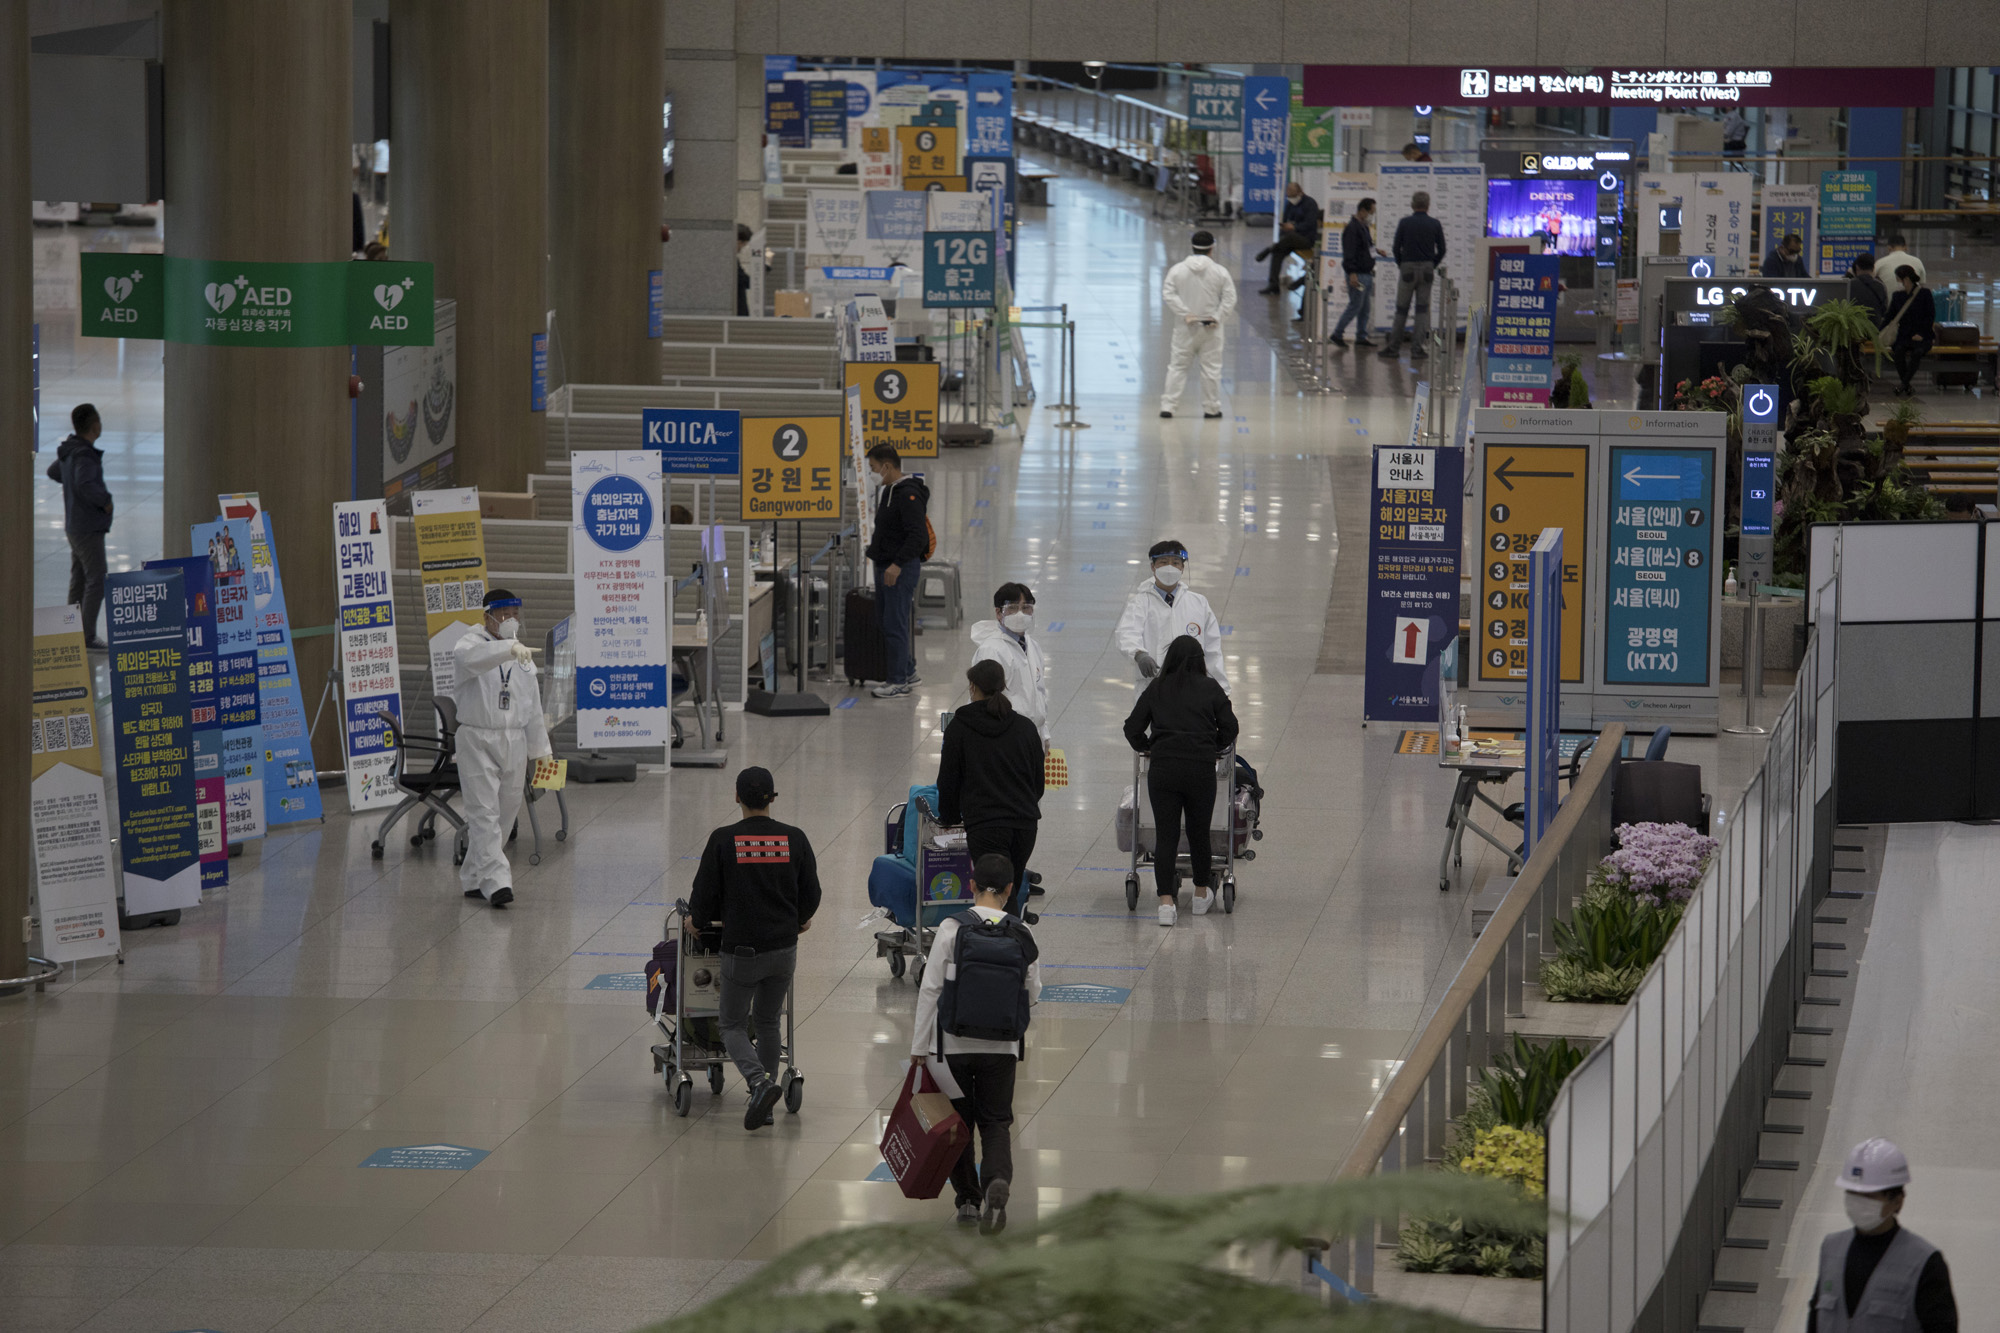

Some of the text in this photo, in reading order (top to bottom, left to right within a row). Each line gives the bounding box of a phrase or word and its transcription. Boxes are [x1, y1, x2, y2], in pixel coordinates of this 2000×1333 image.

[1494, 75, 1535, 92] 만남의
[1610, 86, 1740, 102] Meeting Point (West)
[1196, 99, 1235, 116] KTX
[920, 133, 932, 150] 6
[1842, 174, 1864, 182] 고양시
[1530, 192, 1574, 201] DENTIS
[1849, 193, 1864, 201] 안내
[1704, 214, 1717, 254] 경기도
[934, 238, 988, 265] 12G
[1727, 232, 1739, 258] 대기
[1500, 259, 1525, 273] 해외
[945, 268, 974, 287] 출구
[1499, 277, 1535, 291] 입국자
[243, 286, 292, 306] AED
[928, 290, 992, 301] Gate Exit
[1497, 295, 1544, 309] 교통안내
[1696, 287, 1817, 306] LG TV
[100, 307, 138, 323] AED
[204, 317, 292, 333] 자동심장충격기
[370, 316, 408, 330] AED
[861, 332, 887, 346] 전라북도
[882, 374, 900, 399] 3
[1520, 417, 1572, 426] Information
[1646, 420, 1698, 428] Information
[648, 420, 718, 445] KOICA
[782, 429, 799, 456] 2
[1390, 453, 1424, 465] 서울시
[752, 467, 831, 493] 강원도
[1390, 469, 1424, 481] 안내소
[591, 493, 644, 506] 해외입국자
[1380, 489, 1433, 505] 서울지역
[749, 496, 833, 516] Gangwon-do
[1496, 506, 1502, 520] 1
[596, 508, 638, 521] 충남지역
[1380, 506, 1447, 523] 해외입국자
[1616, 506, 1700, 527] 서울(안내) 7
[338, 512, 361, 537] 해외
[596, 524, 640, 536] 귀가 안내
[1379, 525, 1405, 540] 안내
[1411, 532, 1443, 540] 서울특별시
[1496, 535, 1505, 550] 2
[340, 542, 374, 569] 입국자
[1378, 555, 1390, 563] 모든
[1614, 547, 1699, 568] 서울(버스) 8
[584, 571, 622, 580] 리무진버스를
[1435, 565, 1454, 573] 14일간
[1494, 564, 1504, 578] 3
[1637, 572, 1664, 580] SEOUL
[343, 571, 387, 599] 교통안내
[112, 583, 168, 605] 해외입국자
[221, 586, 248, 604] 입국자
[1381, 590, 1451, 600] (보건소 선별진료소 이용)
[1492, 593, 1503, 607] 4
[1613, 587, 1680, 608] 서울(택시)
[113, 604, 158, 624] 유의사항
[343, 606, 370, 627] 인천공항
[1493, 623, 1503, 636] 5
[349, 632, 388, 647] 인천공항 1터미널
[602, 639, 621, 647] 오시면
[1627, 628, 1678, 648] 광명역
[117, 648, 182, 672] 해외입국자는
[230, 656, 253, 670] 1터미널
[1492, 651, 1502, 664] 6
[1626, 651, 1678, 672] (KTX)
[351, 662, 390, 677] 인천공항 2터미널
[609, 683, 622, 691] 경기
[232, 692, 255, 706] 2터미널
[1398, 696, 1429, 704] 서울특별시
[140, 702, 163, 716] 입국자
[162, 715, 183, 729] 위하여
[355, 734, 383, 749] NEW8844
[152, 746, 188, 763] 부착하오니
[159, 763, 181, 778] 주시기
